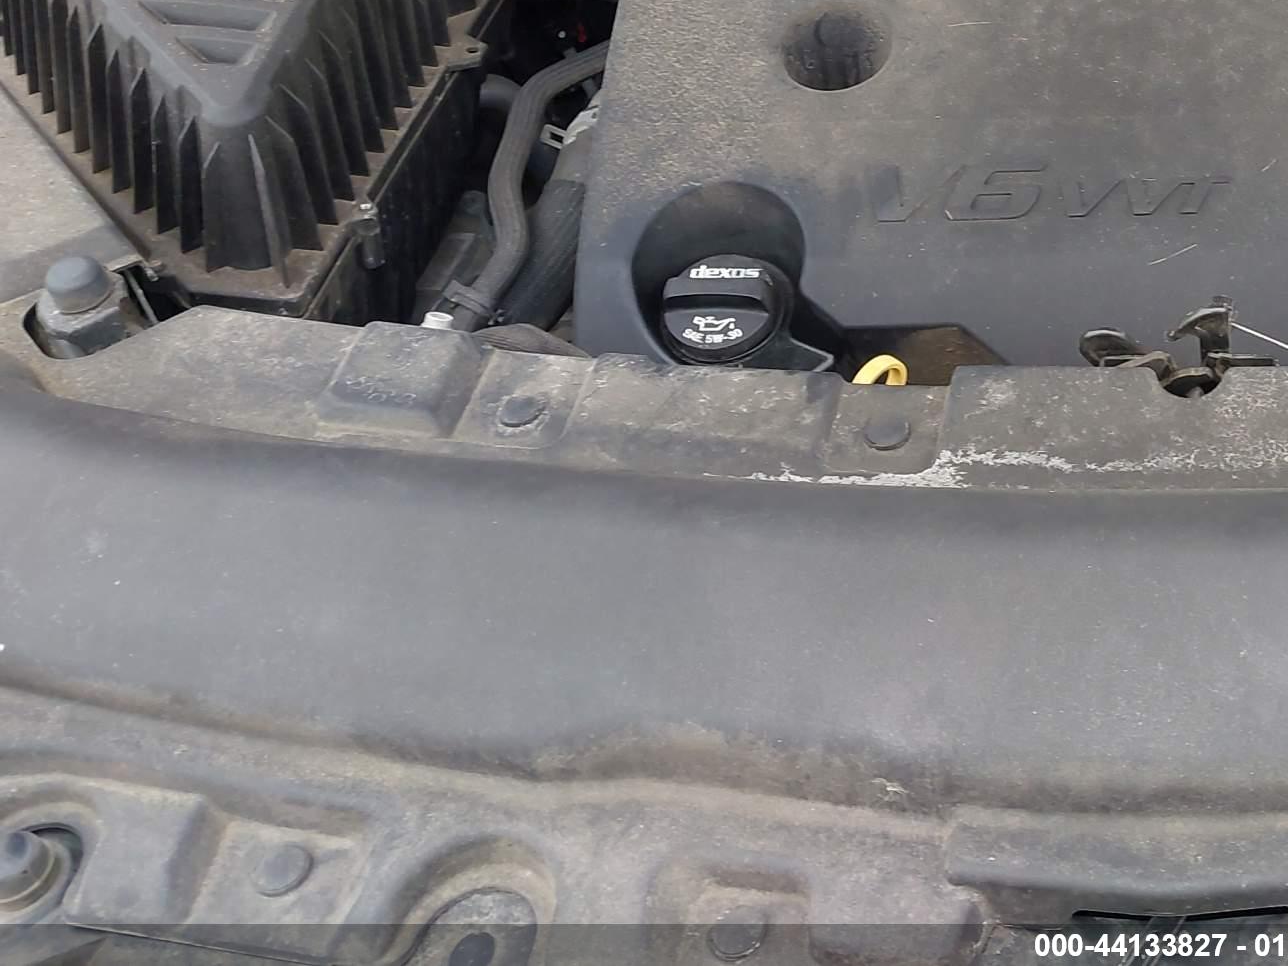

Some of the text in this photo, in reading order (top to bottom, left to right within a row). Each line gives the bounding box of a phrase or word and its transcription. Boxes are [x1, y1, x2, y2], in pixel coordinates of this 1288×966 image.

[864, 164, 1232, 222] V6 VVT
[690, 265, 763, 279] dexos
